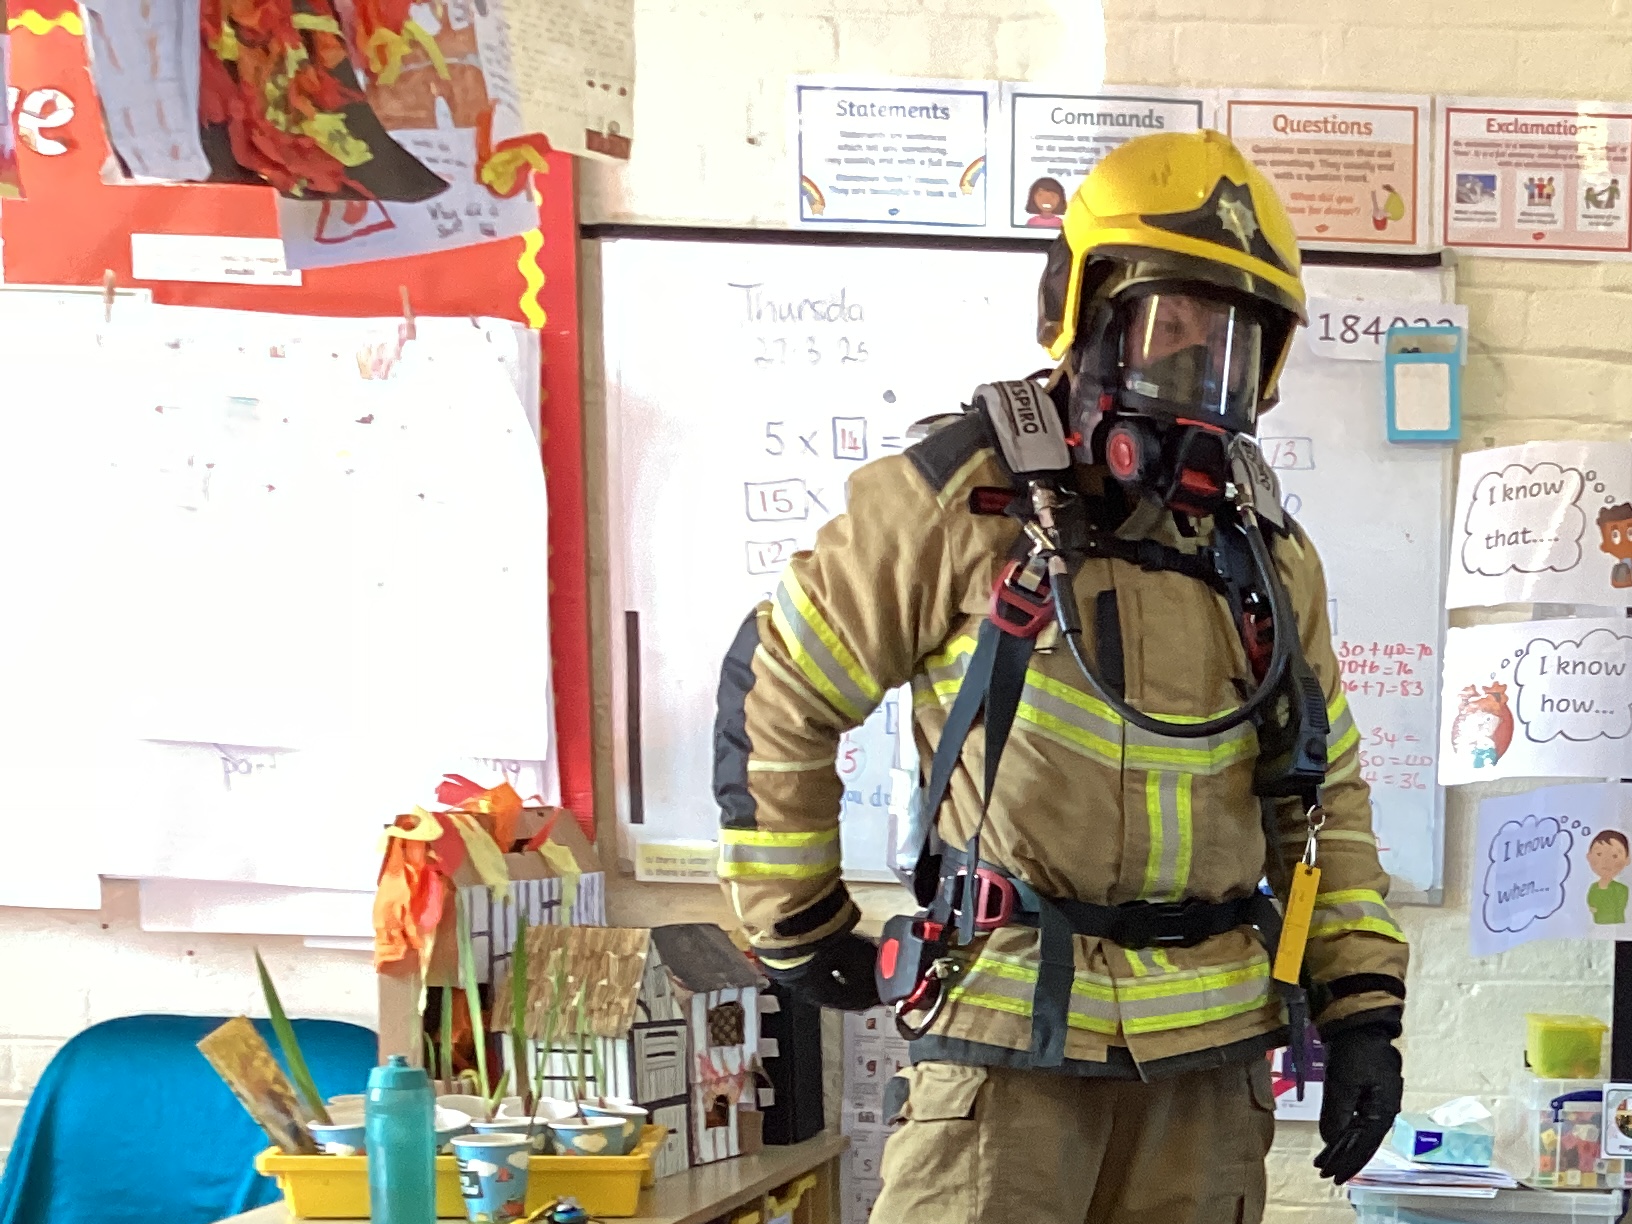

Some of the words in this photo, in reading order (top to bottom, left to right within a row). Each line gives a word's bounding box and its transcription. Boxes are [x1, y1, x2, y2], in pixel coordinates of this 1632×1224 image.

[836, 99, 951, 120] Statements
[1051, 107, 1165, 129] Commands
[1273, 114, 1373, 136] Questions
[1486, 117, 1597, 137] Exclamatio
[766, 421, 785, 456] 5
[1271, 440, 1298, 469] 13
[760, 489, 793, 513] 15
[1502, 478, 1565, 503] know
[758, 541, 788, 567] 12
[1556, 655, 1626, 677] know
[842, 748, 858, 774] 5
[1515, 832, 1557, 859] know
